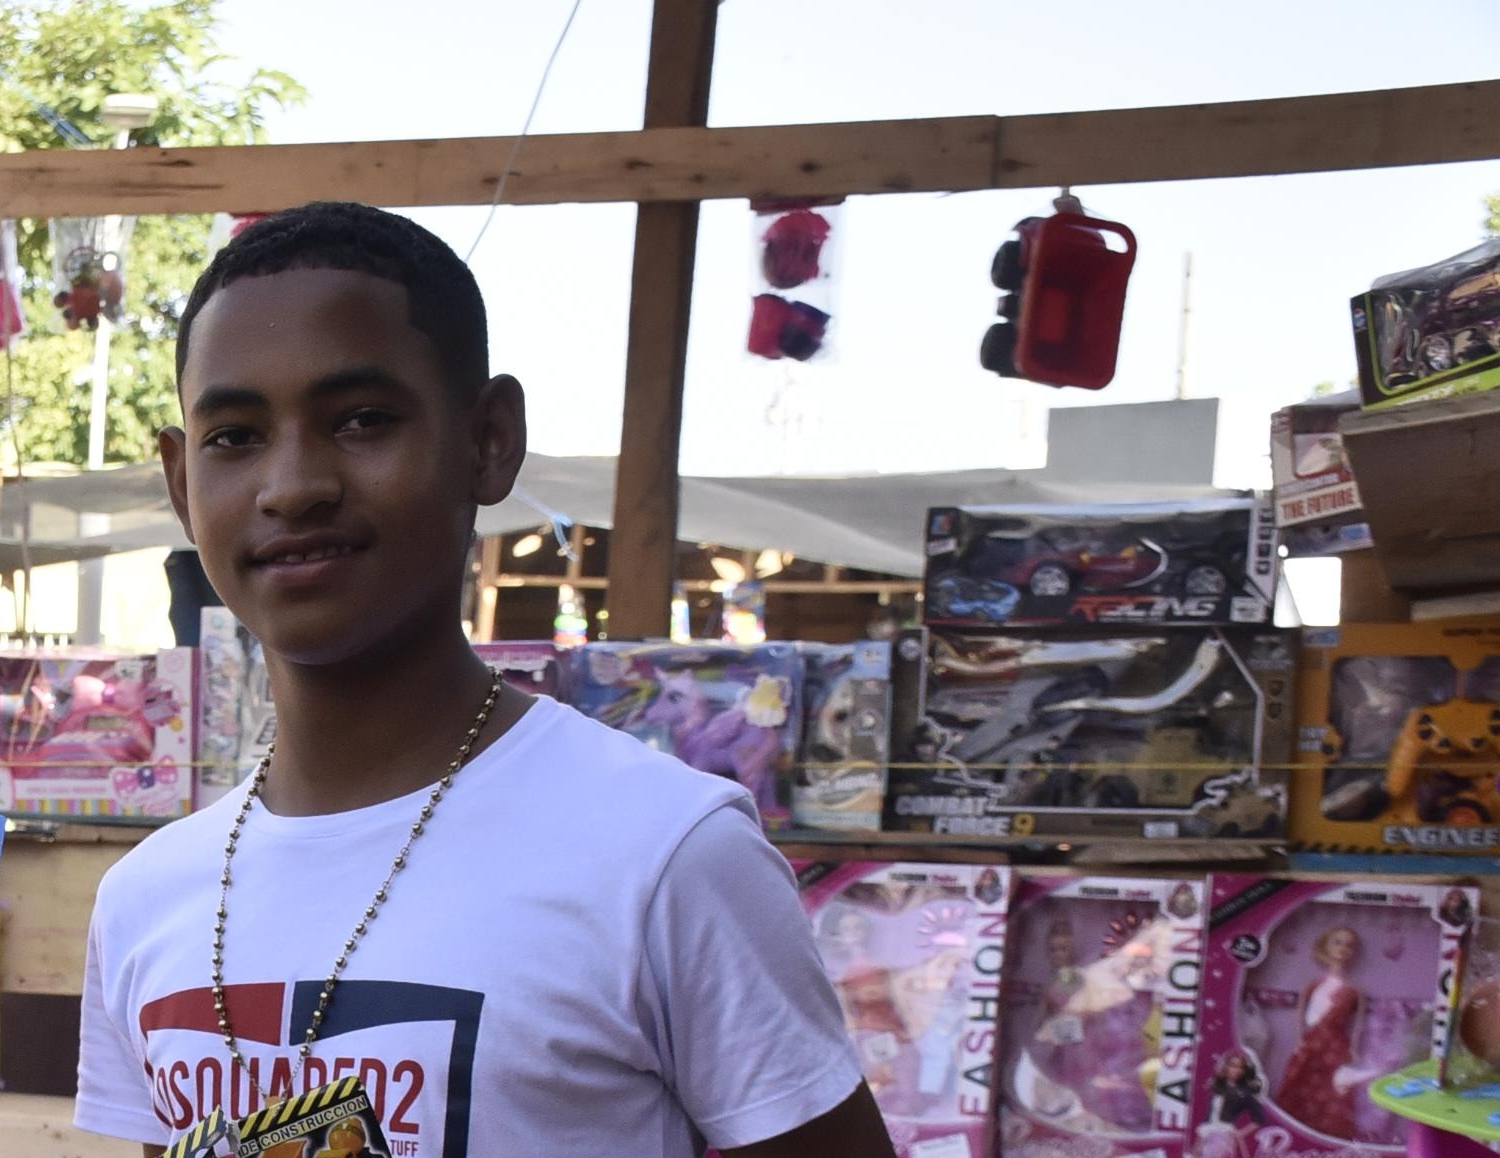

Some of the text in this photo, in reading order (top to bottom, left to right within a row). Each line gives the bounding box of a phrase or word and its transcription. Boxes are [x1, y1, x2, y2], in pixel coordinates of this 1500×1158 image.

[1283, 500, 1306, 519] THE
[959, 911, 1008, 1117] FASHION
[1156, 926, 1203, 1132] FASHION
[239, 1141, 258, 1157] DE
[259, 1095, 369, 1150] CONSTRUCCION
[389, 1139, 420, 1158] TUFF
